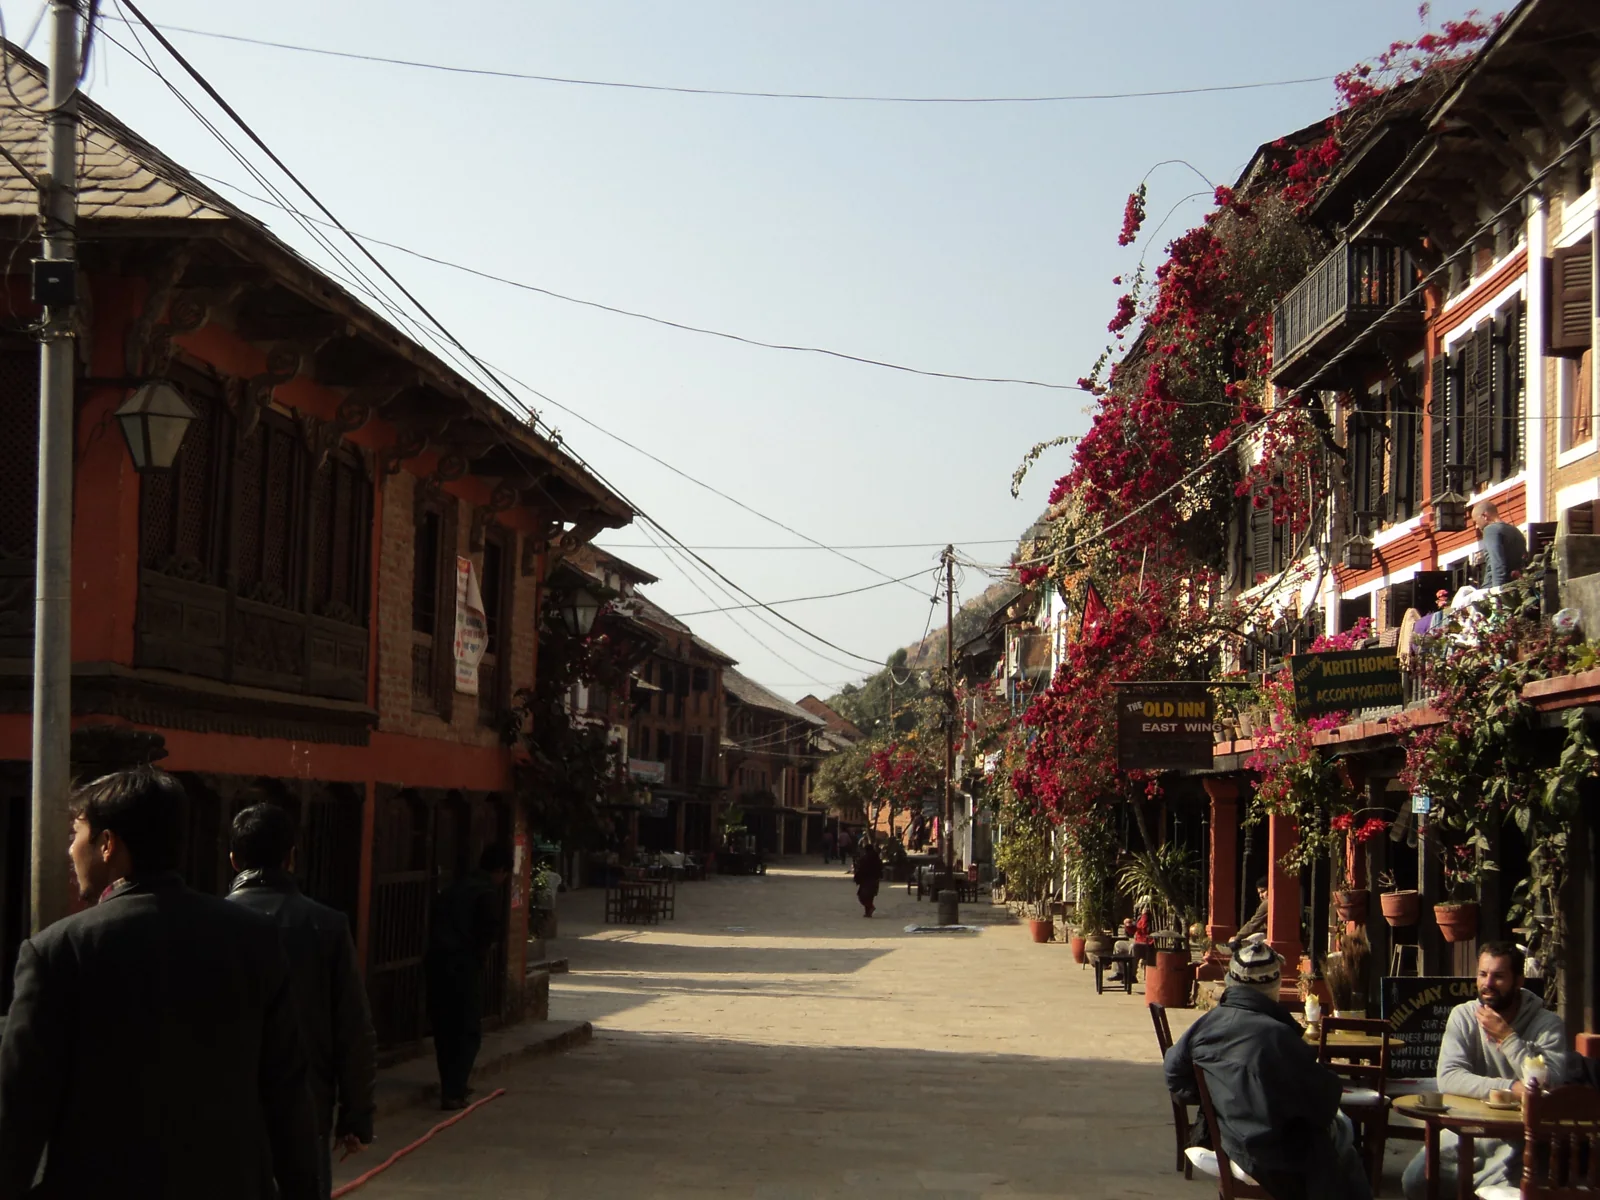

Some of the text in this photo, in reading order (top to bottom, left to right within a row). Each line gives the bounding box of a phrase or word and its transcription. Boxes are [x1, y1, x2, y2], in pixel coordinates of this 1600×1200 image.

[1322, 655, 1398, 677] KRITI HOME
[1316, 682, 1403, 703] ACCOMMODATION
[1126, 701, 1206, 718] THE OLD INN
[1142, 723, 1222, 732] EAST WING
[1390, 982, 1478, 1031] HILL WAY CAF
[1433, 1005, 1451, 1016] BAN
[1424, 1032, 1441, 1042] INDI
[1391, 1059, 1417, 1070] PARTY
